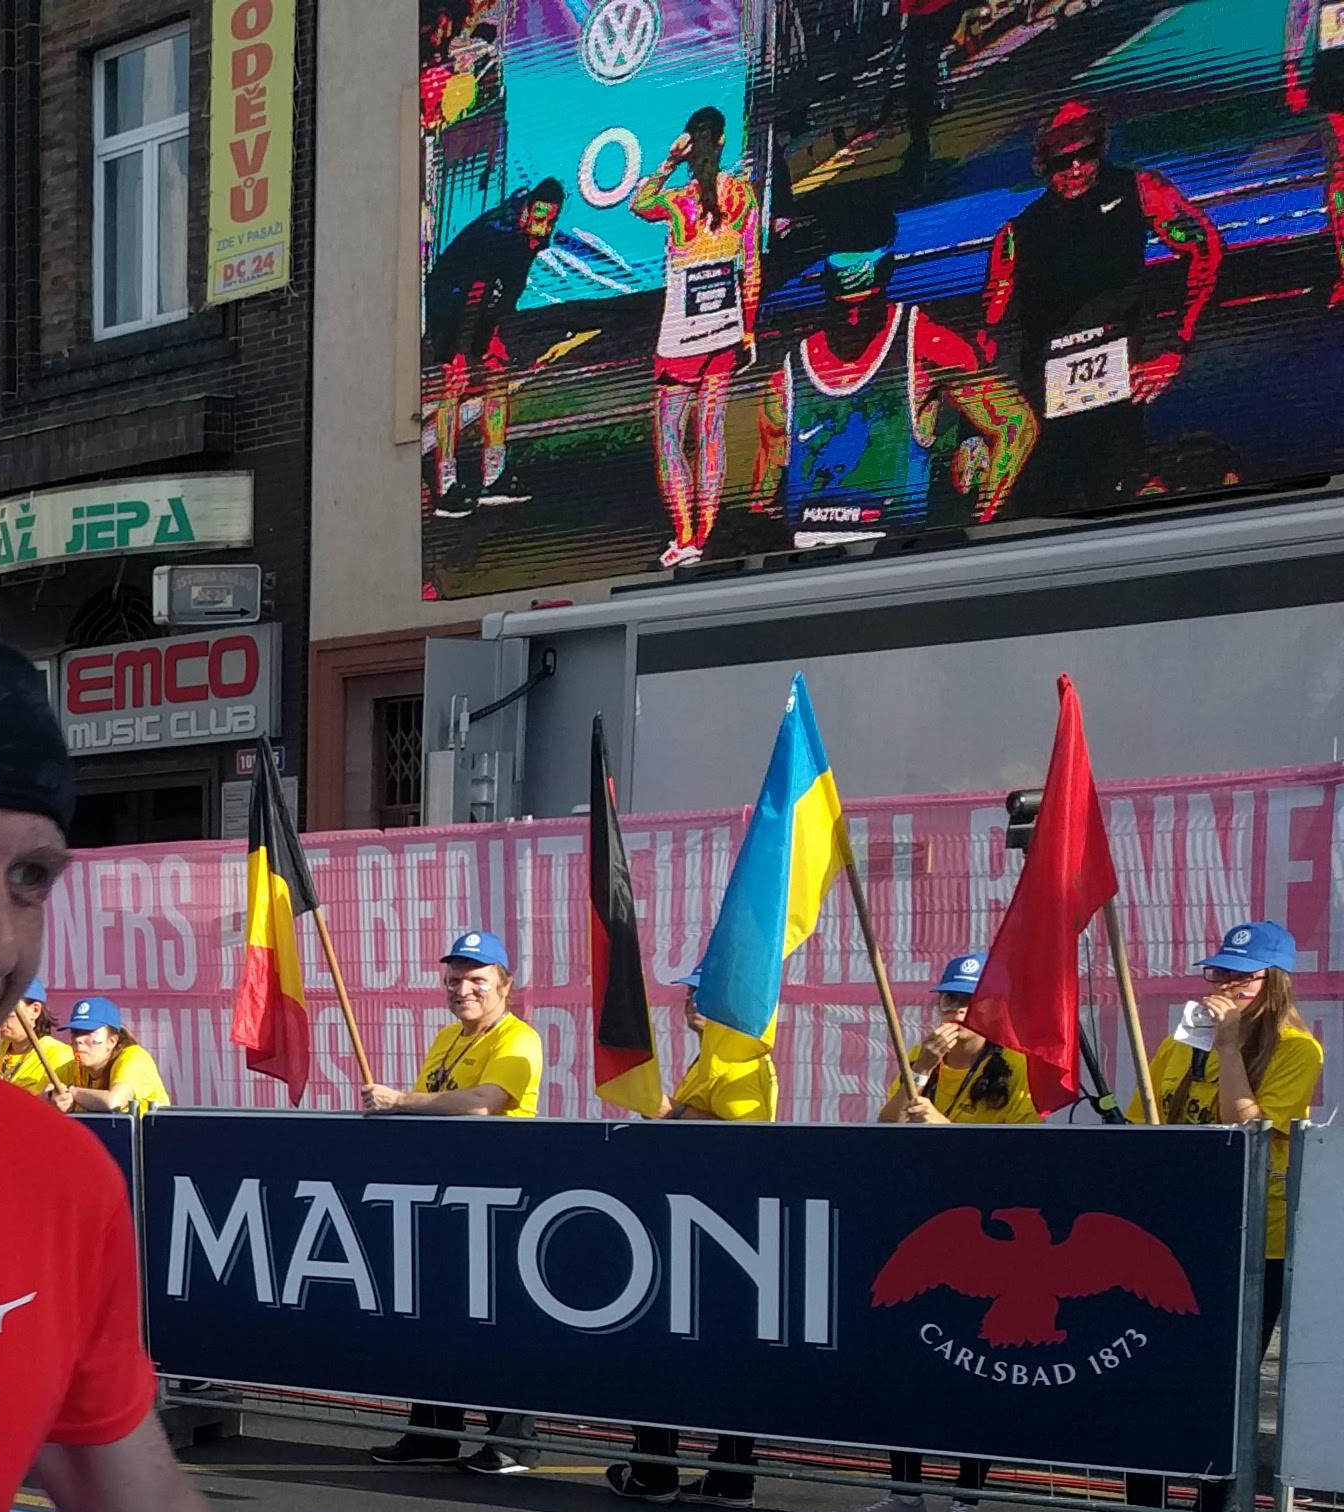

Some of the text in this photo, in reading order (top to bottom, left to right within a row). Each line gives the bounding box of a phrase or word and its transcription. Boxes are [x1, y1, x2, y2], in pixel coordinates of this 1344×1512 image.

[223, 252, 274, 282] DC 24
[65, 496, 196, 553] JEPA
[67, 634, 260, 715] EMCO
[67, 705, 256, 751] MUSIC CLUB
[166, 1177, 839, 1349] MATTONI
[919, 1322, 1148, 1387] CARLSBAD 1873
